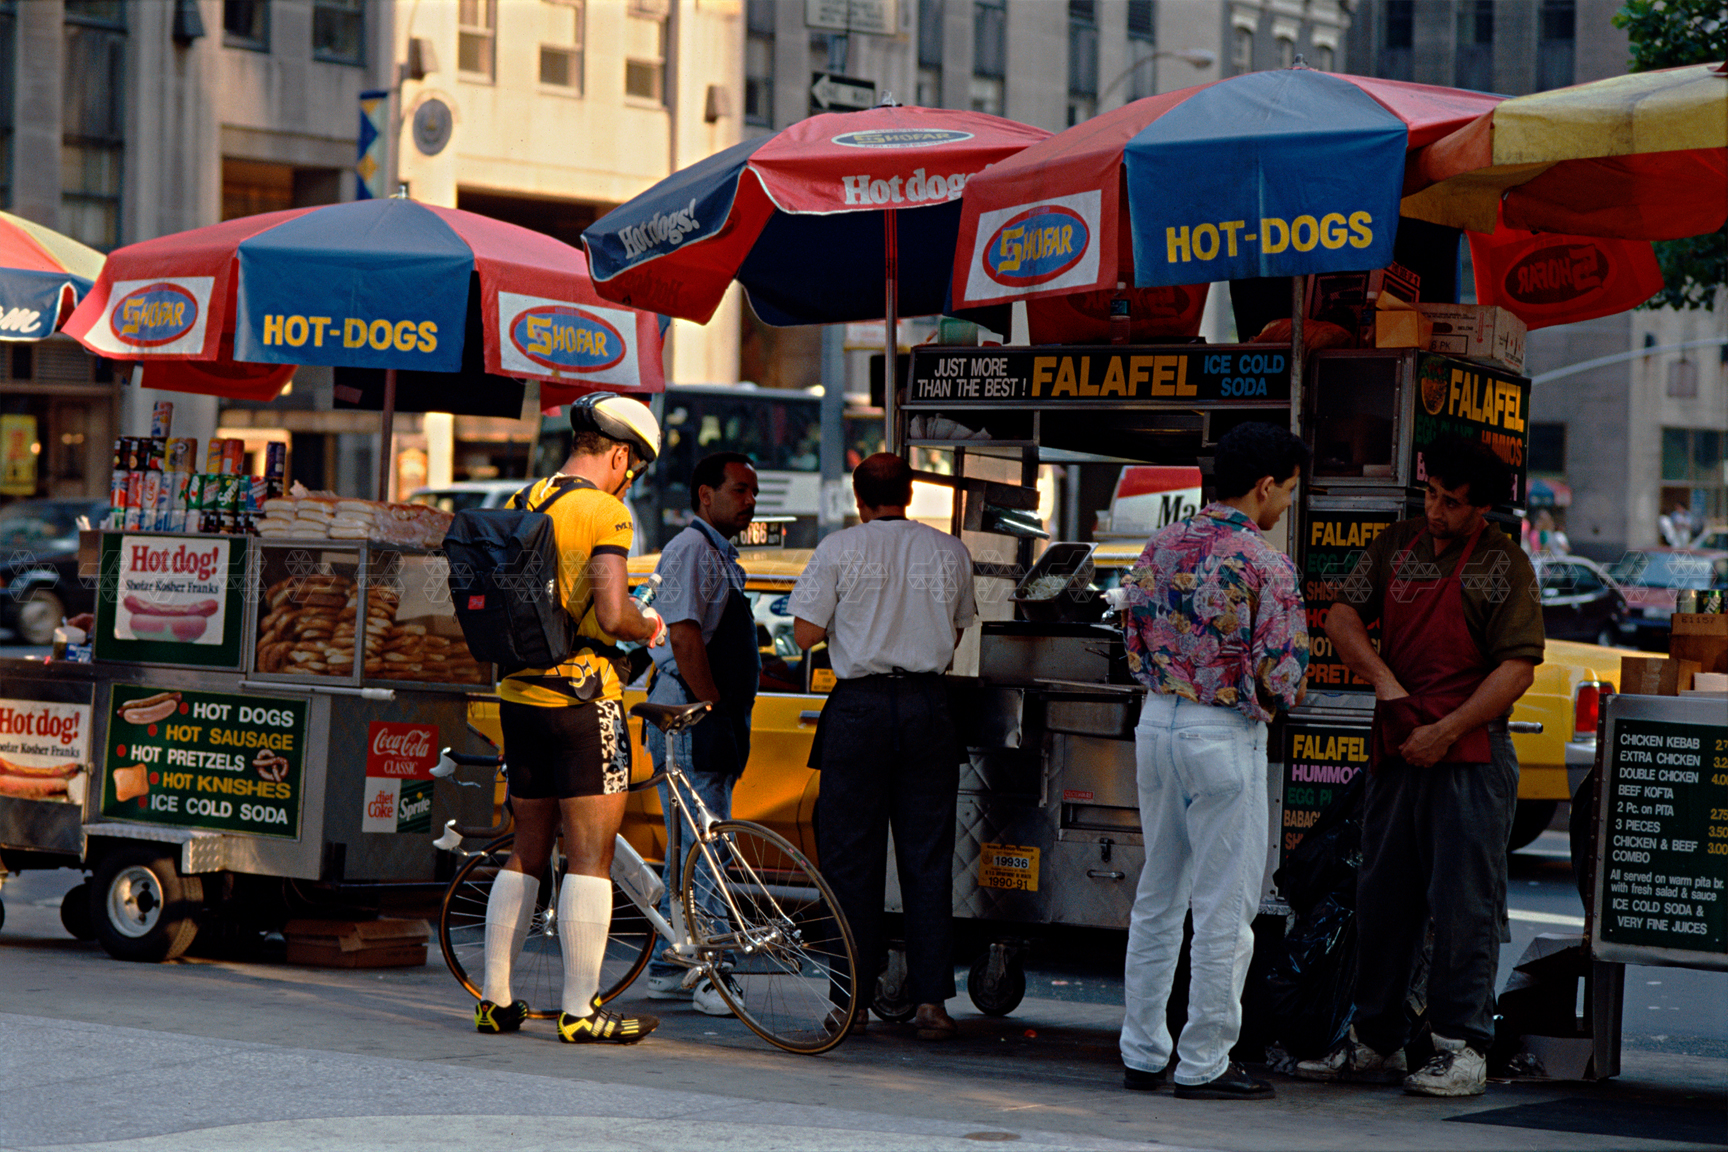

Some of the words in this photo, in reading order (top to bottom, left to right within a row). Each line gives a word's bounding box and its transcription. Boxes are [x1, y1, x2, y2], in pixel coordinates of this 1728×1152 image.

[853, 132, 952, 144] SHOFAR
[842, 173, 905, 205] Hot
[905, 164, 994, 202] dog
[618, 221, 654, 260] Hot
[647, 198, 700, 245] dogs!
[1166, 210, 1373, 264] HOT-DOGS
[997, 224, 1075, 277] SHOFAR
[120, 297, 186, 338] SHOFAR
[263, 314, 438, 353] HOT-DOGS
[526, 314, 609, 358] SHOFAR
[1440, 341, 1452, 351] PK
[934, 358, 967, 377] JUST
[971, 357, 1008, 377] MORE
[1204, 355, 1231, 374] ICE
[1239, 354, 1285, 375] COLD
[1031, 355, 1198, 397] FALAFEL
[1221, 376, 1268, 397] SODA
[917, 379, 952, 398] THAN
[956, 379, 981, 398] THE
[1448, 368, 1525, 433] FALAFEL
[1311, 521, 1392, 547] FALAFE
[130, 545, 170, 573] Hot
[172, 544, 219, 581] dog!
[1307, 553, 1338, 574] EGG
[155, 581, 186, 594] Kosher
[187, 581, 219, 595] Franks
[193, 702, 231, 721] HOT
[239, 706, 294, 728] DOGS
[0, 707, 34, 736] Hot
[36, 708, 80, 745] dog!
[166, 724, 202, 743] HOT
[209, 728, 294, 750] SAUSAGE
[1292, 733, 1370, 762] FALAFEL
[1620, 733, 1664, 748] CHICKEN
[1666, 735, 1700, 750] KEBAB
[21, 742, 49, 756] Kosher
[51, 744, 80, 758] Franks
[131, 744, 162, 763] HOT
[167, 748, 245, 772] PRETZELS
[1620, 750, 1652, 764] EXTRA
[1656, 752, 1701, 767] CHICKEN
[384, 760, 418, 775] CLASSIC
[1619, 766, 1656, 781] DOUBLE
[1658, 768, 1699, 784] CHICKEN
[163, 771, 193, 790] HOT
[197, 776, 291, 799] KNISHES
[1618, 784, 1641, 797] BEEF
[1644, 785, 1674, 800] KOFTA
[375, 790, 394, 804] diet
[1287, 786, 1314, 806] EGG
[151, 794, 179, 812] ICE
[186, 797, 232, 817] COLD
[240, 803, 288, 825] SODA
[368, 801, 393, 818] Coke
[400, 796, 430, 821] Sprite
[1617, 801, 1624, 812] 2
[1641, 805, 1652, 814] on
[1654, 803, 1674, 817] PITA
[1615, 818, 1622, 830] 3
[1625, 819, 1661, 834] PIECES
[1613, 835, 1657, 850] CHICKEN
[1660, 838, 1668, 851] &
[1671, 839, 1698, 853] BEEF
[995, 856, 1028, 869] 19936
[1612, 849, 1651, 864] COMBO
[989, 876, 1028, 890] 1990-91
[1610, 869, 1621, 881] All
[1623, 870, 1652, 884] served
[1654, 875, 1666, 885] on
[1668, 876, 1692, 887] warm
[1694, 876, 1711, 891] pita
[1610, 882, 1629, 894] with
[1630, 883, 1652, 896] fresh
[1655, 885, 1678, 898] salad
[1680, 887, 1688, 899] &
[1691, 889, 1717, 902] sauce
[1612, 897, 1629, 910] ICE
[1632, 898, 1660, 913] COLD
[1663, 901, 1692, 916] SODA
[1696, 904, 1704, 918] &
[1617, 915, 1644, 929] VERY
[1646, 917, 1669, 932] FINE
[1671, 919, 1708, 935] JUICES
